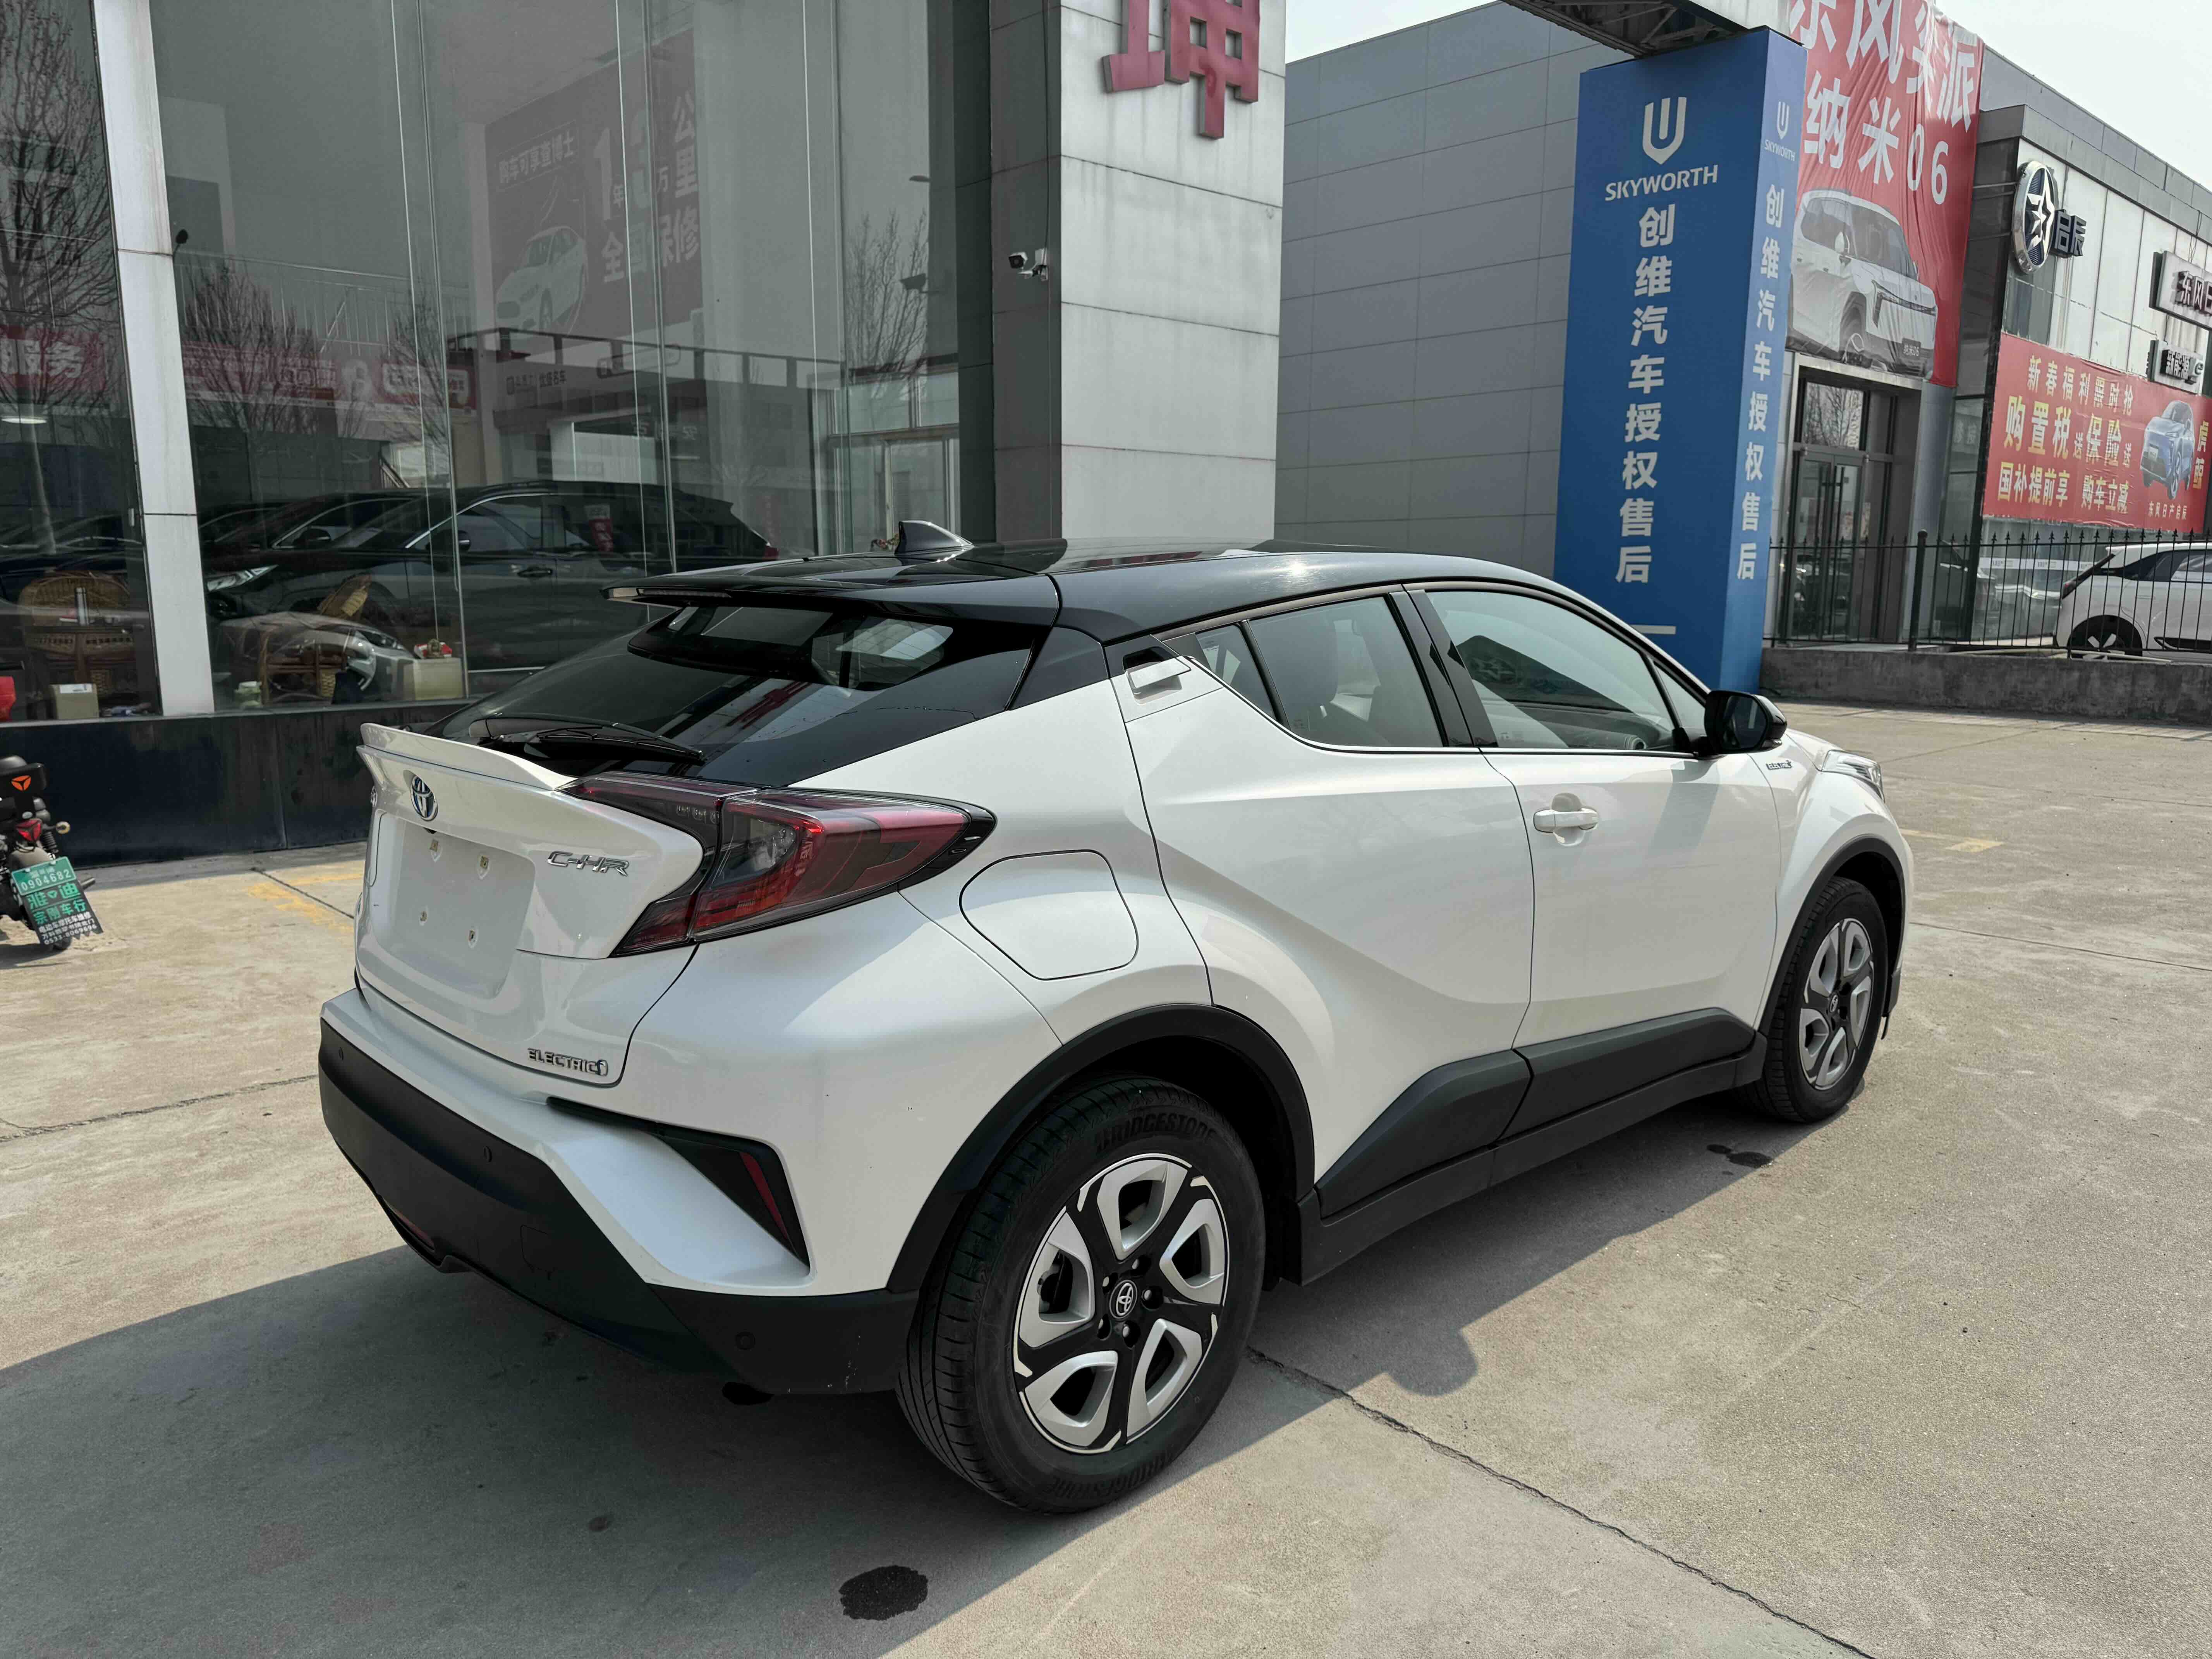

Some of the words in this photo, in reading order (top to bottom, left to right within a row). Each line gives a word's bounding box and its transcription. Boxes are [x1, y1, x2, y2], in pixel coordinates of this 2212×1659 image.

[1764, 139, 1796, 161] SKYWORTH
[1803, 70, 1949, 204] 纳米06
[1605, 165, 1718, 201] SKYWORTH
[2054, 210, 2087, 256] 启辰
[2165, 349, 2189, 380] 新能源
[1616, 203, 1675, 583] 创维汽车授权售后
[1737, 184, 1784, 580] 创维汽车授权售后
[1998, 462, 2070, 508] 国补提前享
[2148, 501, 2187, 520] 东风日产启辰
[21, 869, 72, 891] 0904682
[547, 851, 629, 877] C-HR
[527, 1048, 598, 1075] ELECTRIC
